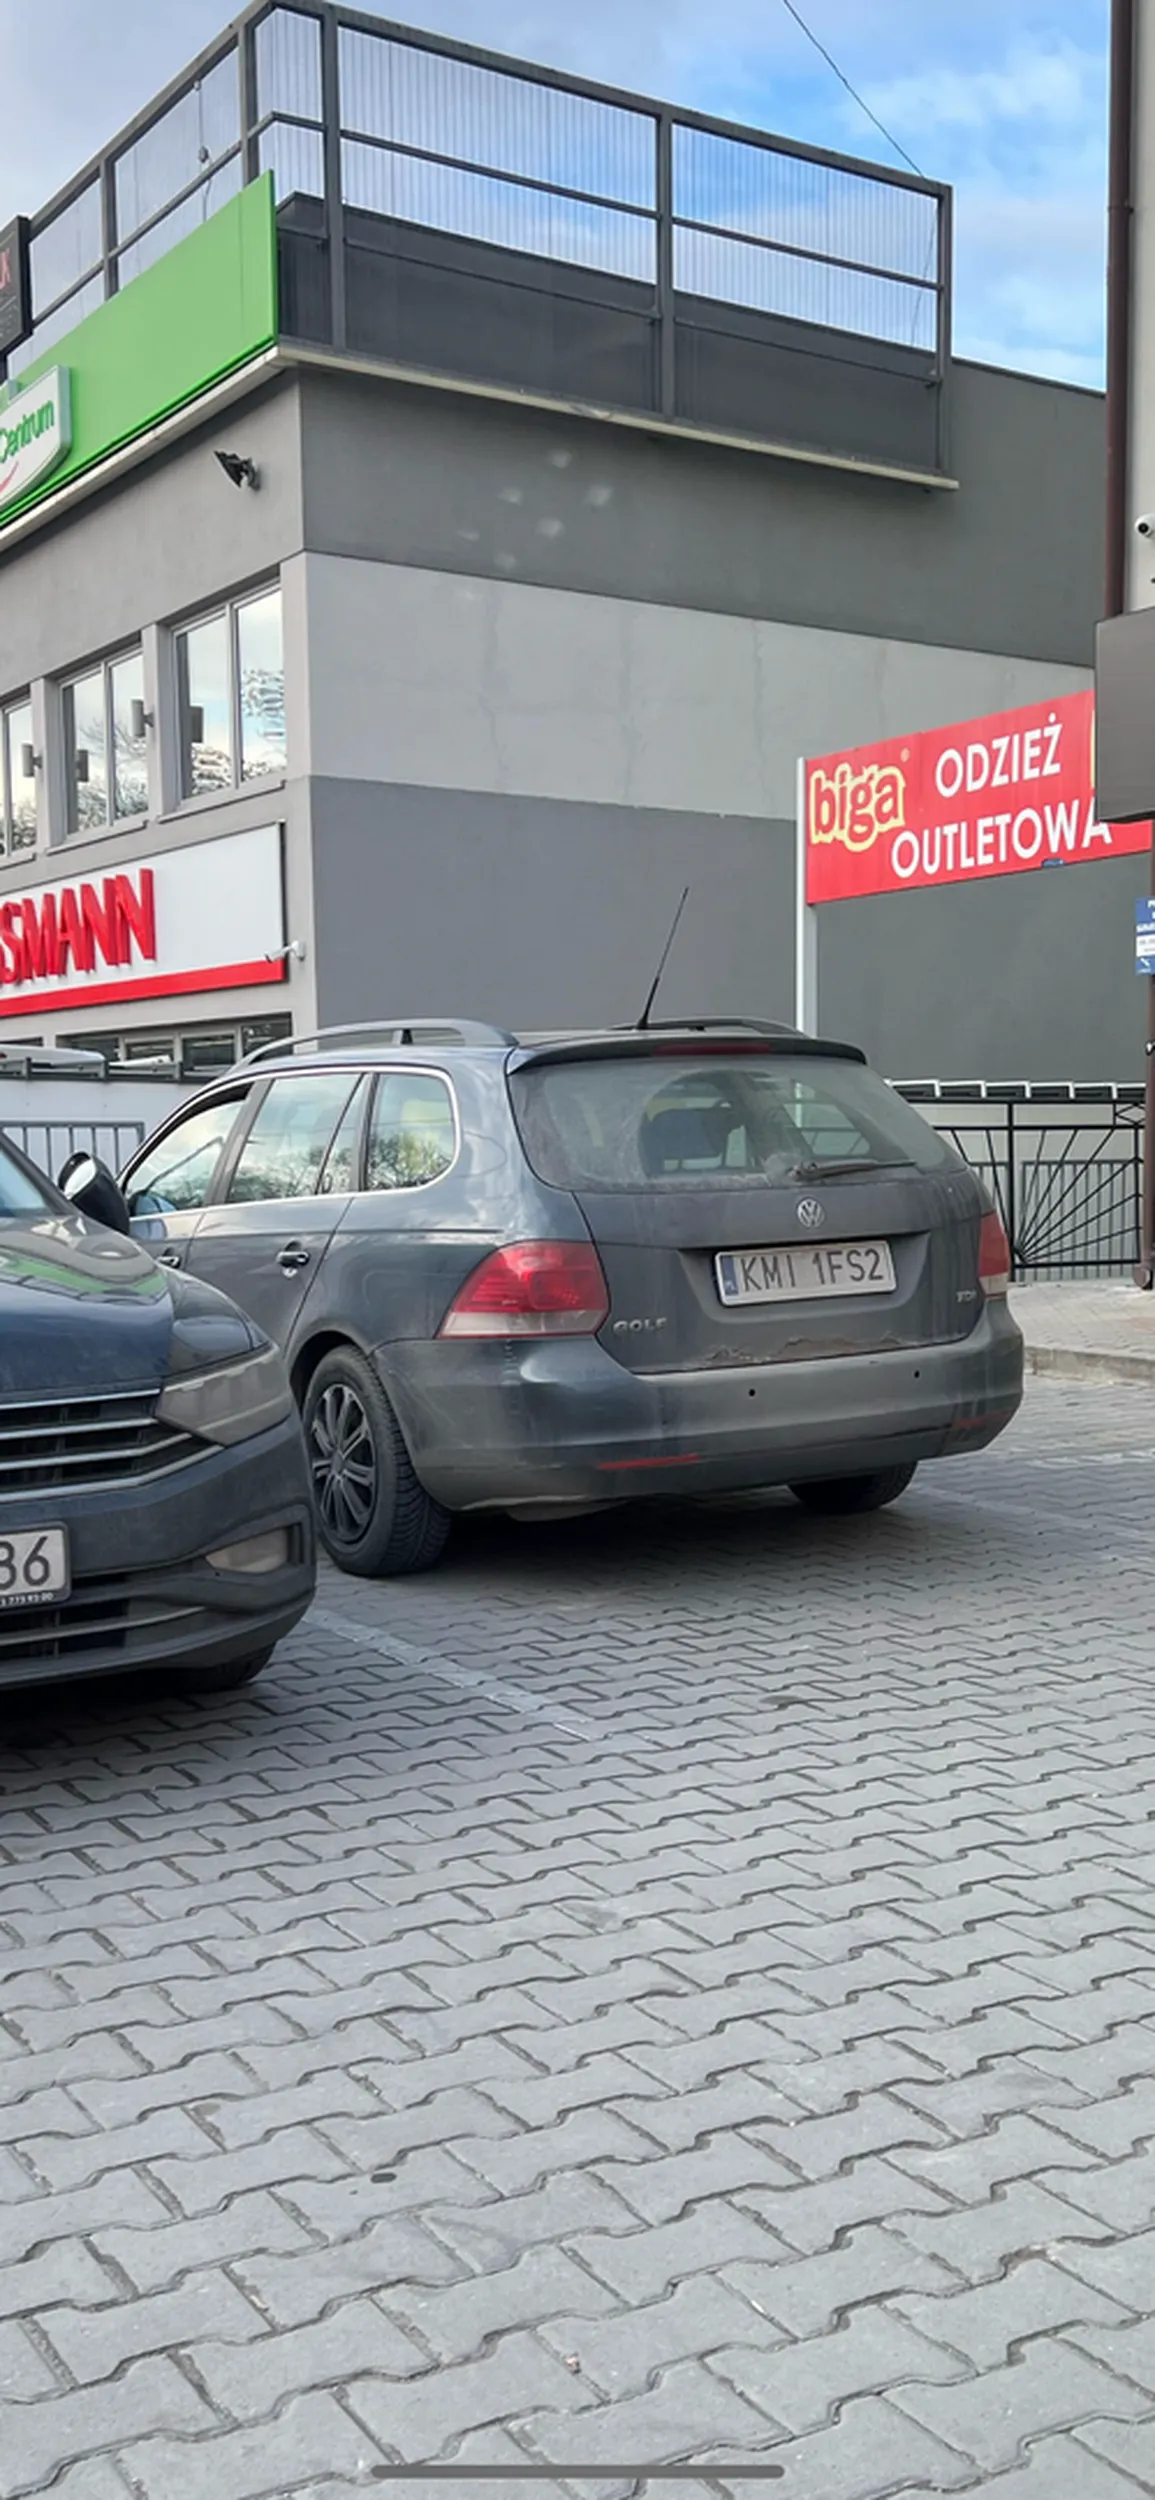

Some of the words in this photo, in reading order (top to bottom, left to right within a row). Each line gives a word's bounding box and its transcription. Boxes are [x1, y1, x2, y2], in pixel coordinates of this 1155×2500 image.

[935, 712, 1063, 798] ODZIEŻ
[810, 762, 906, 852] biga
[891, 796, 1113, 878] OUTLETOWA
[740, 1255, 796, 1292] KMI
[812, 1248, 884, 1286] 1FS2
[613, 1317, 667, 1335] GOLF
